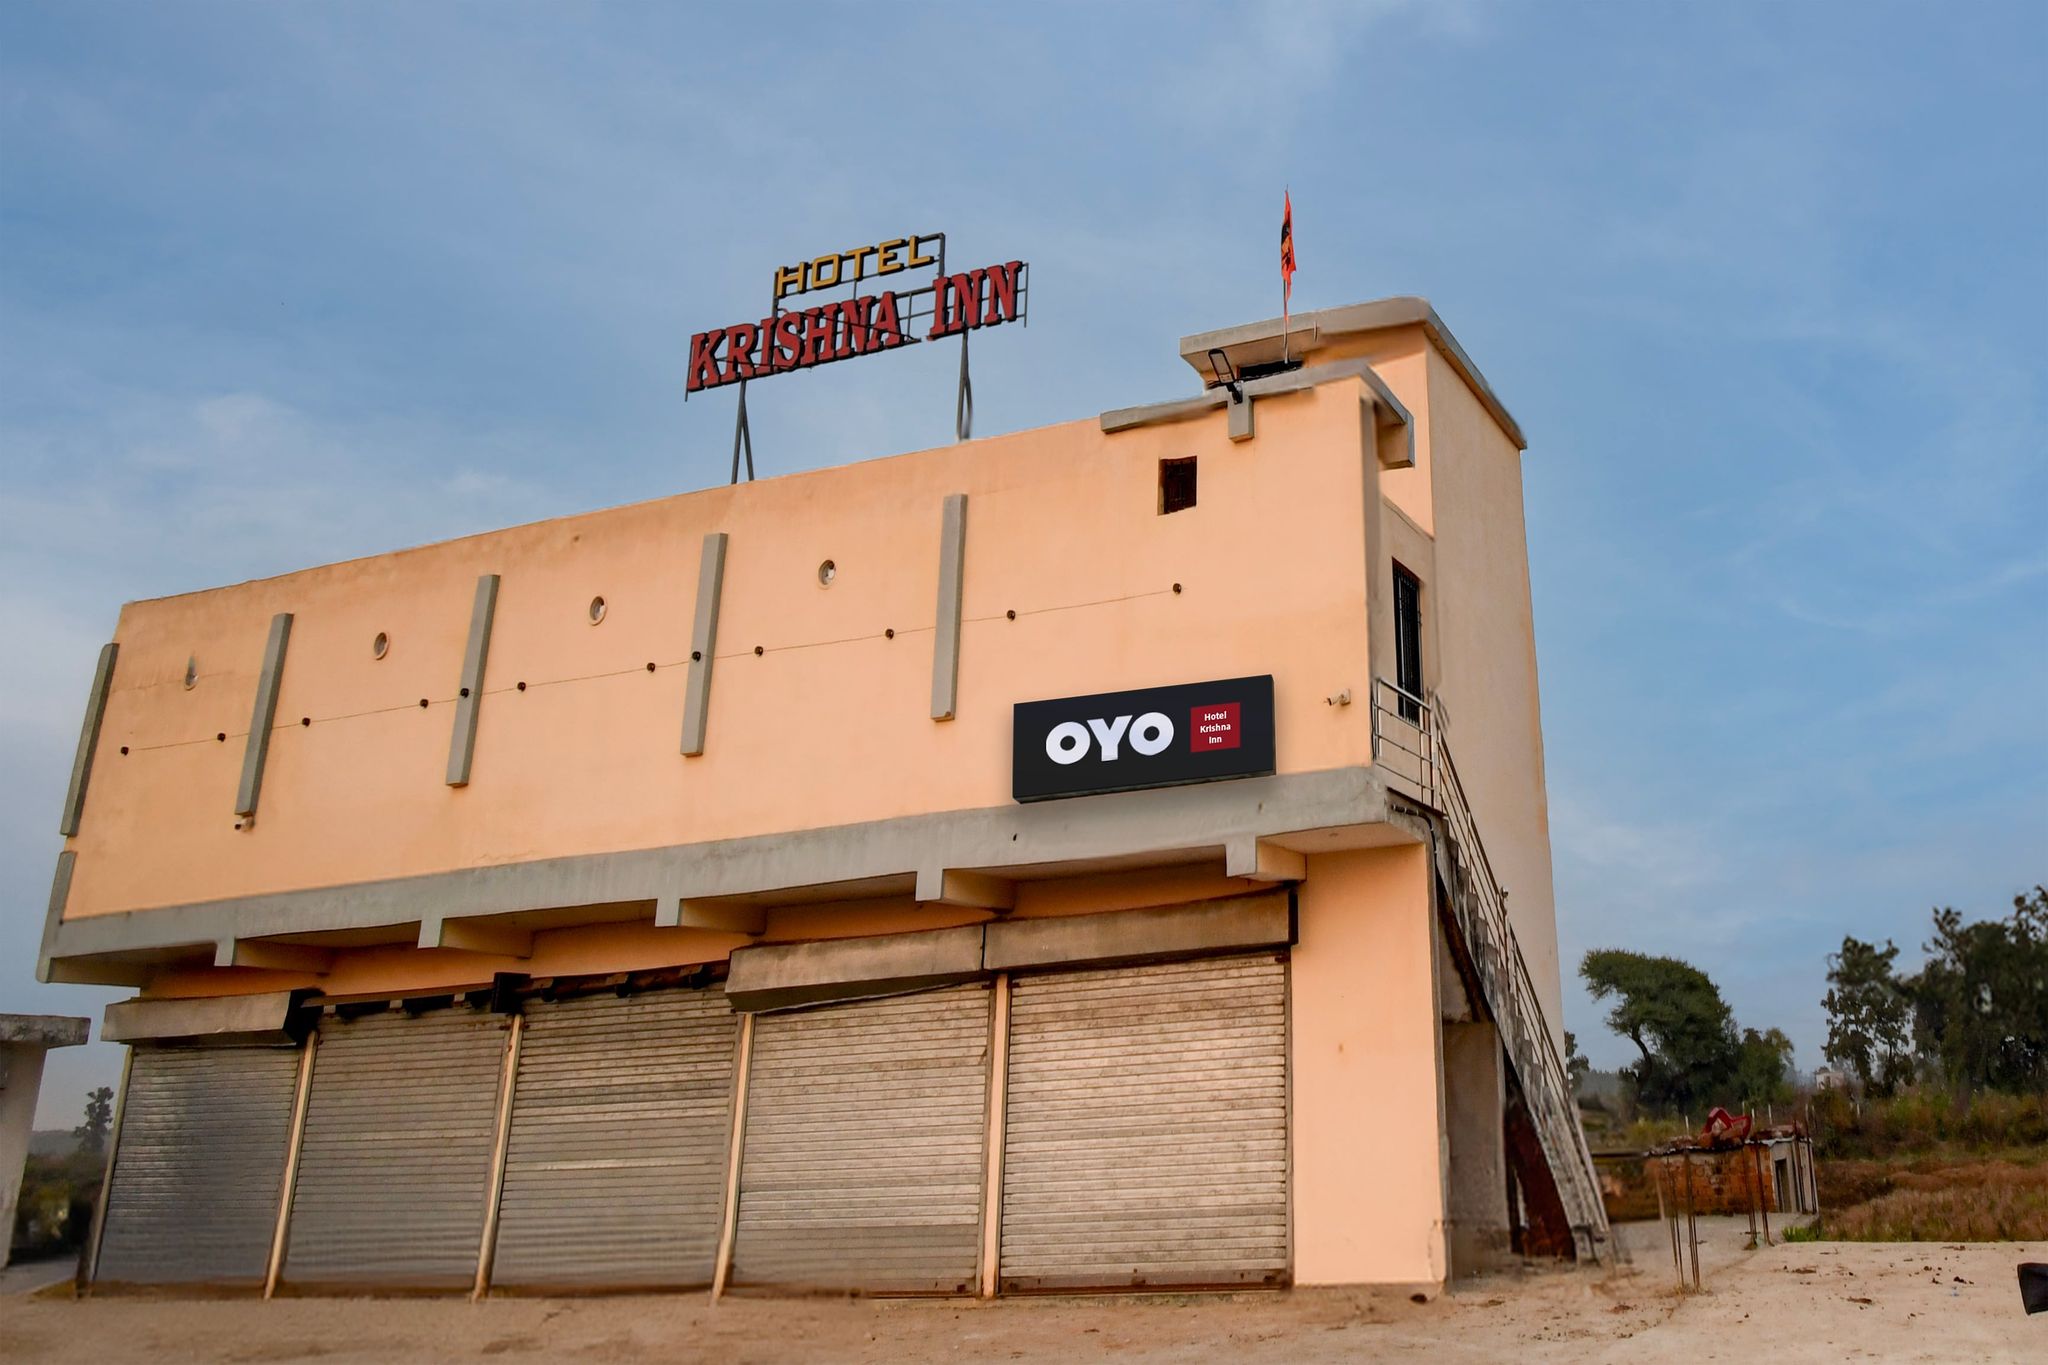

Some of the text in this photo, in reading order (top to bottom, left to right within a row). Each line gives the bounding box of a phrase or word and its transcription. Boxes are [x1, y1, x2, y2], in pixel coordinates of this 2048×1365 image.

[776, 235, 934, 298] HOTEL
[687, 260, 1023, 391] KRISHNA INN
[1200, 723, 1231, 733] Krishna
[1204, 711, 1227, 721] Hotel
[1046, 711, 1174, 765] OYO
[1208, 736, 1222, 744] Inn
